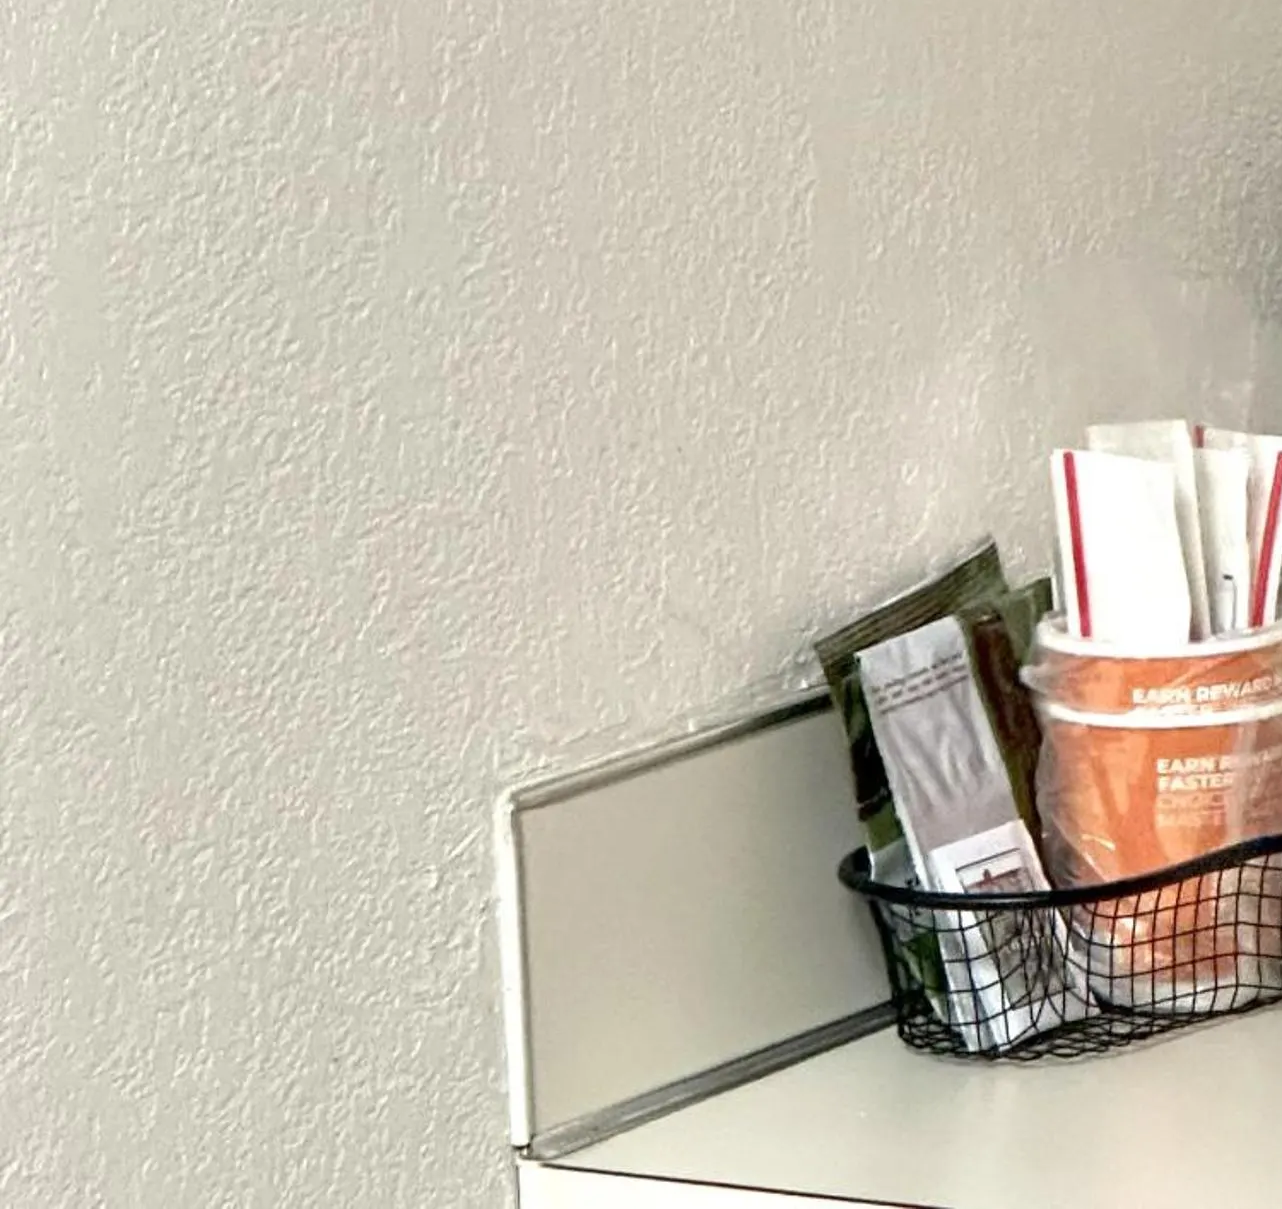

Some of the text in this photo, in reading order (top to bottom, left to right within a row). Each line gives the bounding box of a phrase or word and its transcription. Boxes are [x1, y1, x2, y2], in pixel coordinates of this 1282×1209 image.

[1132, 685, 1191, 703] EARN
[1157, 757, 1215, 773] EARN
[1158, 773, 1234, 791] FASTER
